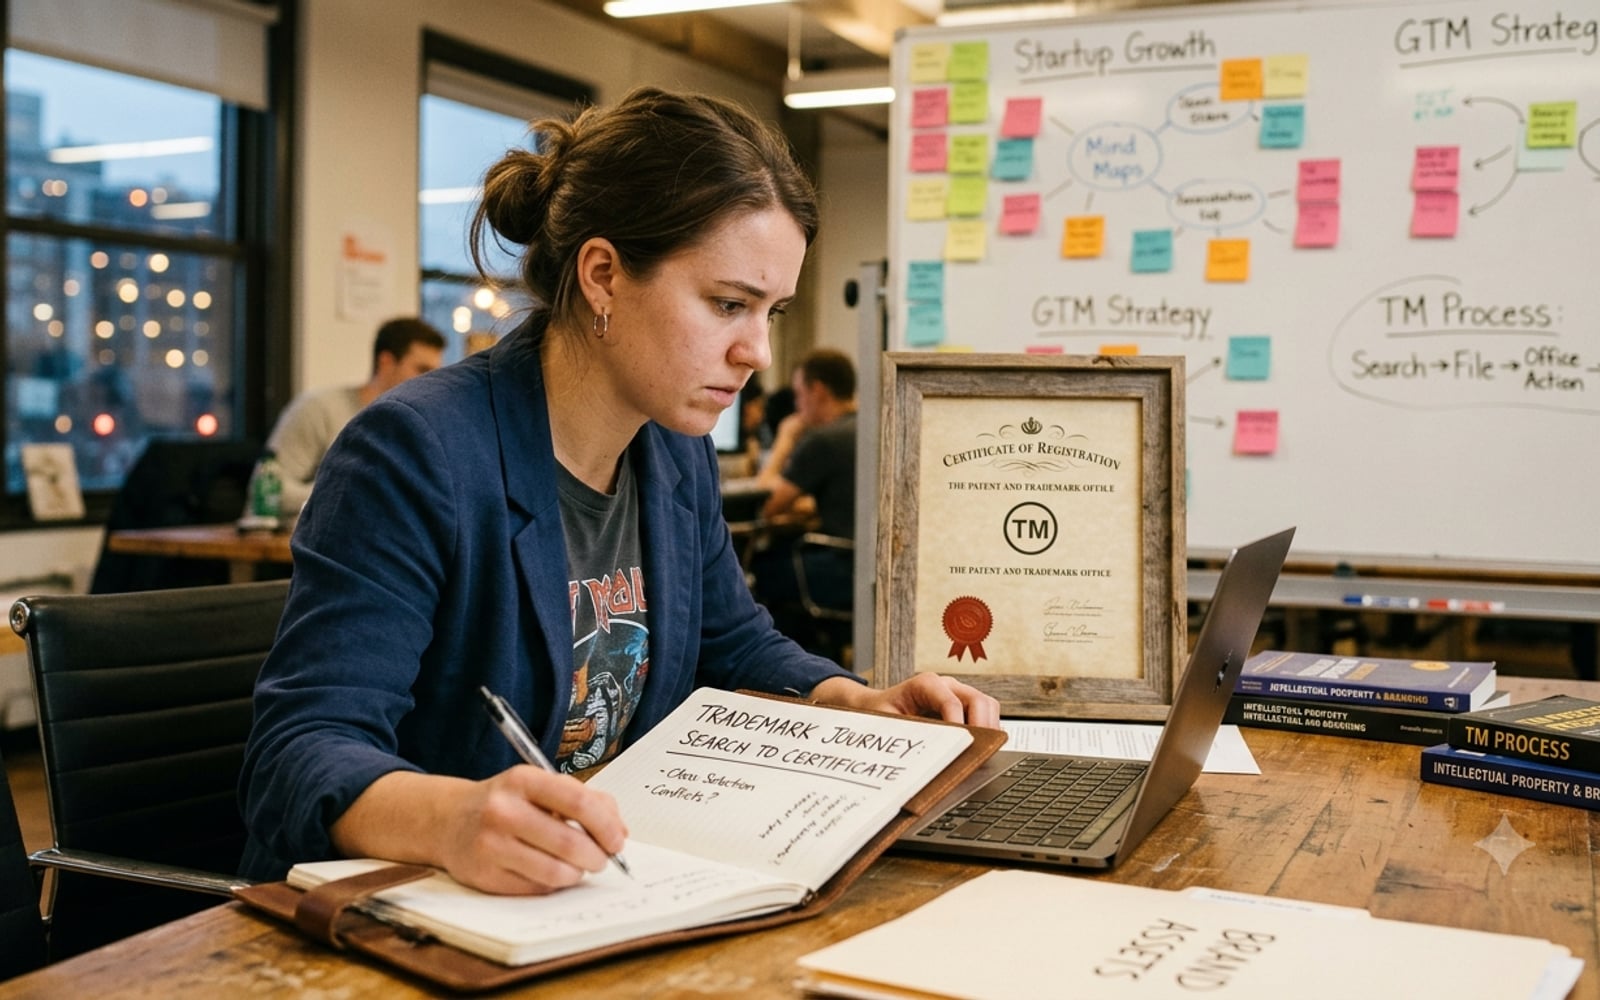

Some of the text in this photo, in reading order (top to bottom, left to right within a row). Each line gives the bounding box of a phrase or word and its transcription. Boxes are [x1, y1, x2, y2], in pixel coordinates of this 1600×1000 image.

[1394, 12, 1598, 56] GTM Strateg
[1014, 38, 1114, 76] Startup
[1125, 31, 1217, 63] Growth
[1086, 137, 1136, 157] Mind
[1093, 162, 1144, 183] Maps
[1032, 295, 1212, 340] GTM Strategy
[1377, 291, 1563, 327] TM Process:
[1352, 346, 1580, 380] Search File Office
[1524, 371, 1584, 390] Action
[1019, 443, 1034, 454] OF
[949, 482, 965, 490] THE
[968, 482, 1001, 491] PATENT
[1004, 483, 1022, 491] AND
[1025, 483, 1080, 492] TRADEMARK
[1012, 519, 1048, 539] TM
[949, 566, 966, 574] THE
[969, 566, 1001, 575] PATENT
[1024, 567, 1078, 576] TRADEMARK
[694, 704, 820, 740] TRADEMARK
[679, 730, 906, 781] SEARCH TO CERTIFICATE
[1465, 726, 1571, 761] TM PROCESS
[1433, 761, 1600, 800] INTELLECTUAL PROPERTY & BR
[1093, 917, 1198, 980] ASSETS
[1176, 928, 1276, 991] BRAND
